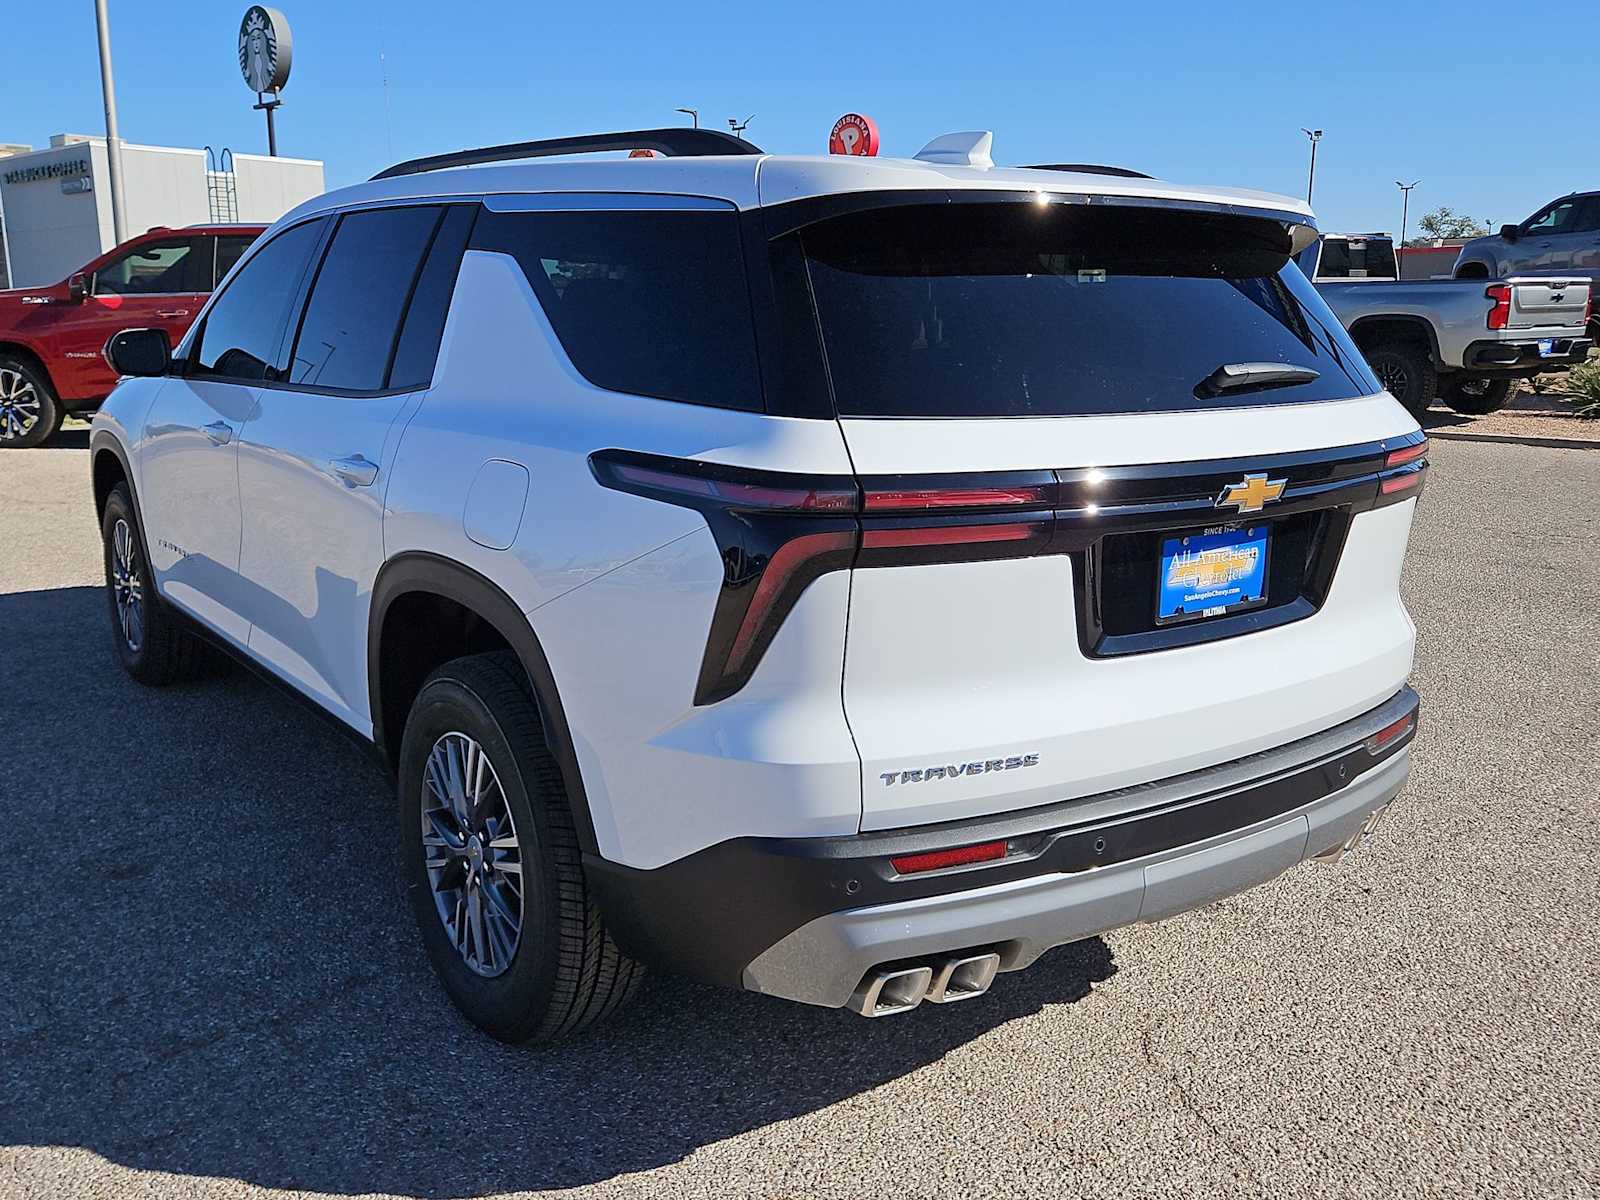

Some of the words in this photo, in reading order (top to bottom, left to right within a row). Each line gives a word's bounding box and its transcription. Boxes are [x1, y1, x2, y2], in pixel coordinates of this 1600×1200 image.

[831, 116, 869, 140] LOUISIANA
[839, 127, 859, 155] P
[1203, 526, 1223, 536] SINCE
[1168, 549, 1191, 570] All
[1196, 545, 1259, 565] American
[1184, 588, 1240, 602] SanAngeloChevy.com
[880, 753, 1040, 787] TRAVERSE
